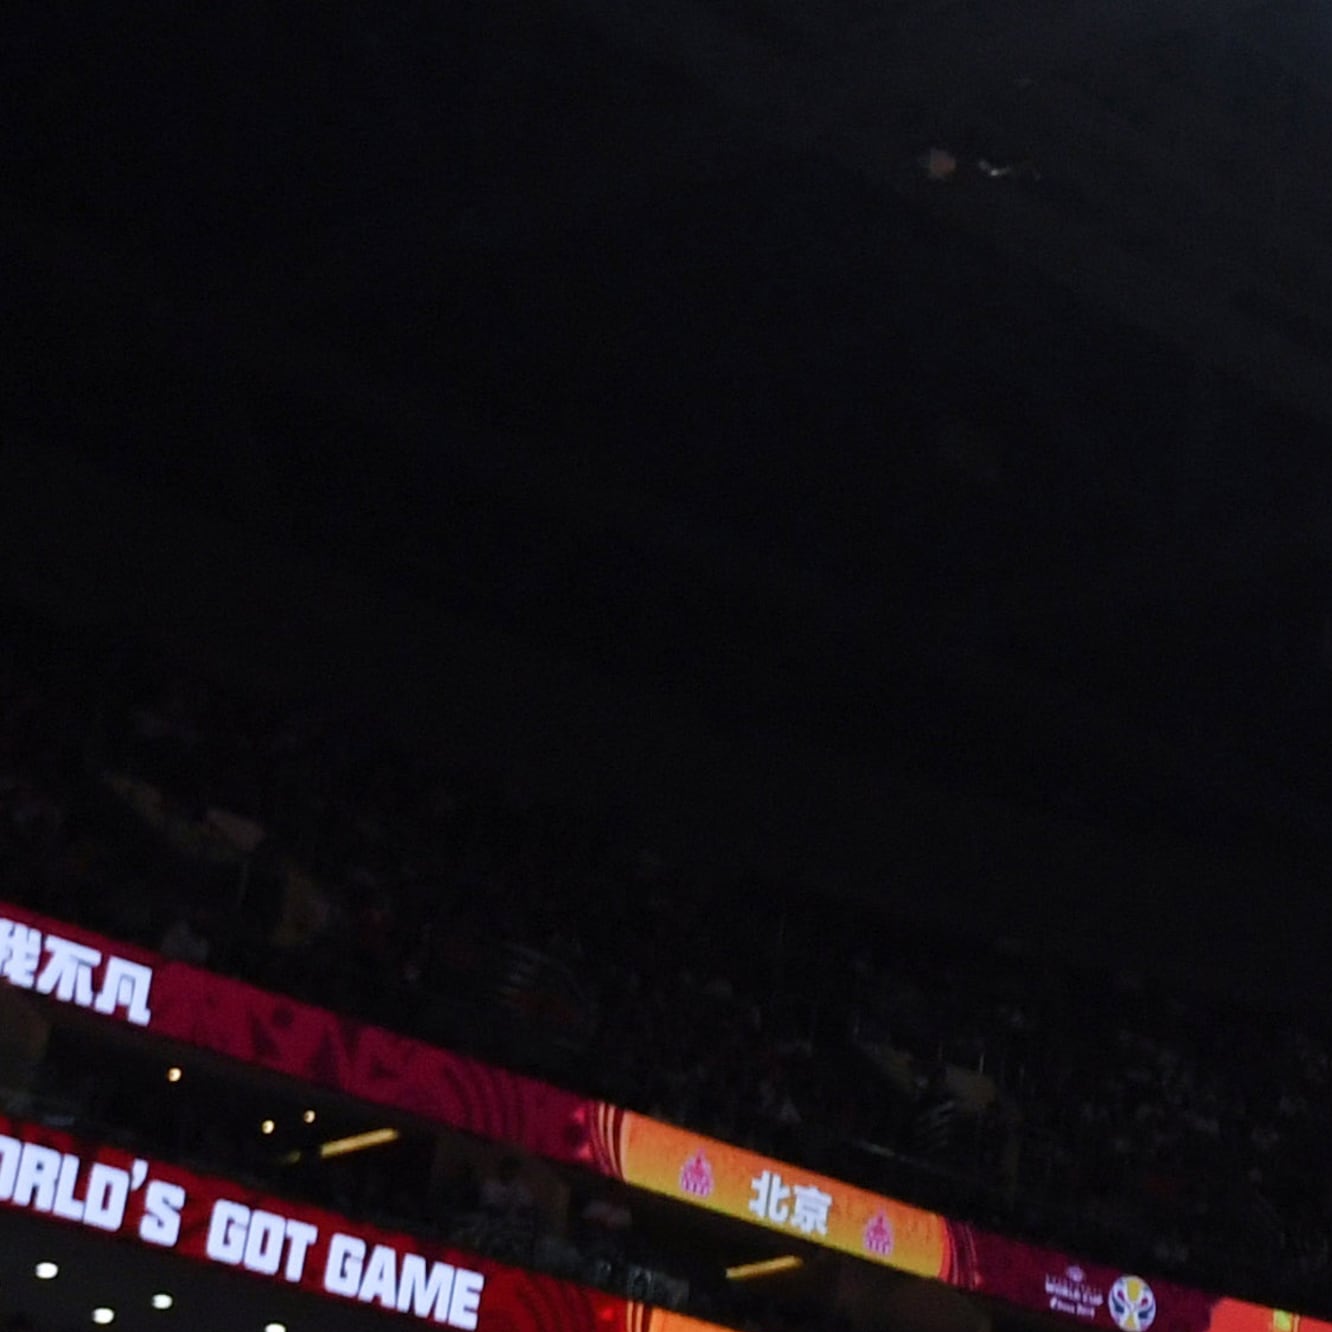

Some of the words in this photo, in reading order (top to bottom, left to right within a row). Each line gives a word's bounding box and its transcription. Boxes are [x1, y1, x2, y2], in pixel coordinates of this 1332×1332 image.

[747, 1169, 834, 1237] 北京
[205, 1199, 318, 1282] GOT
[323, 1233, 485, 1331] GAME
